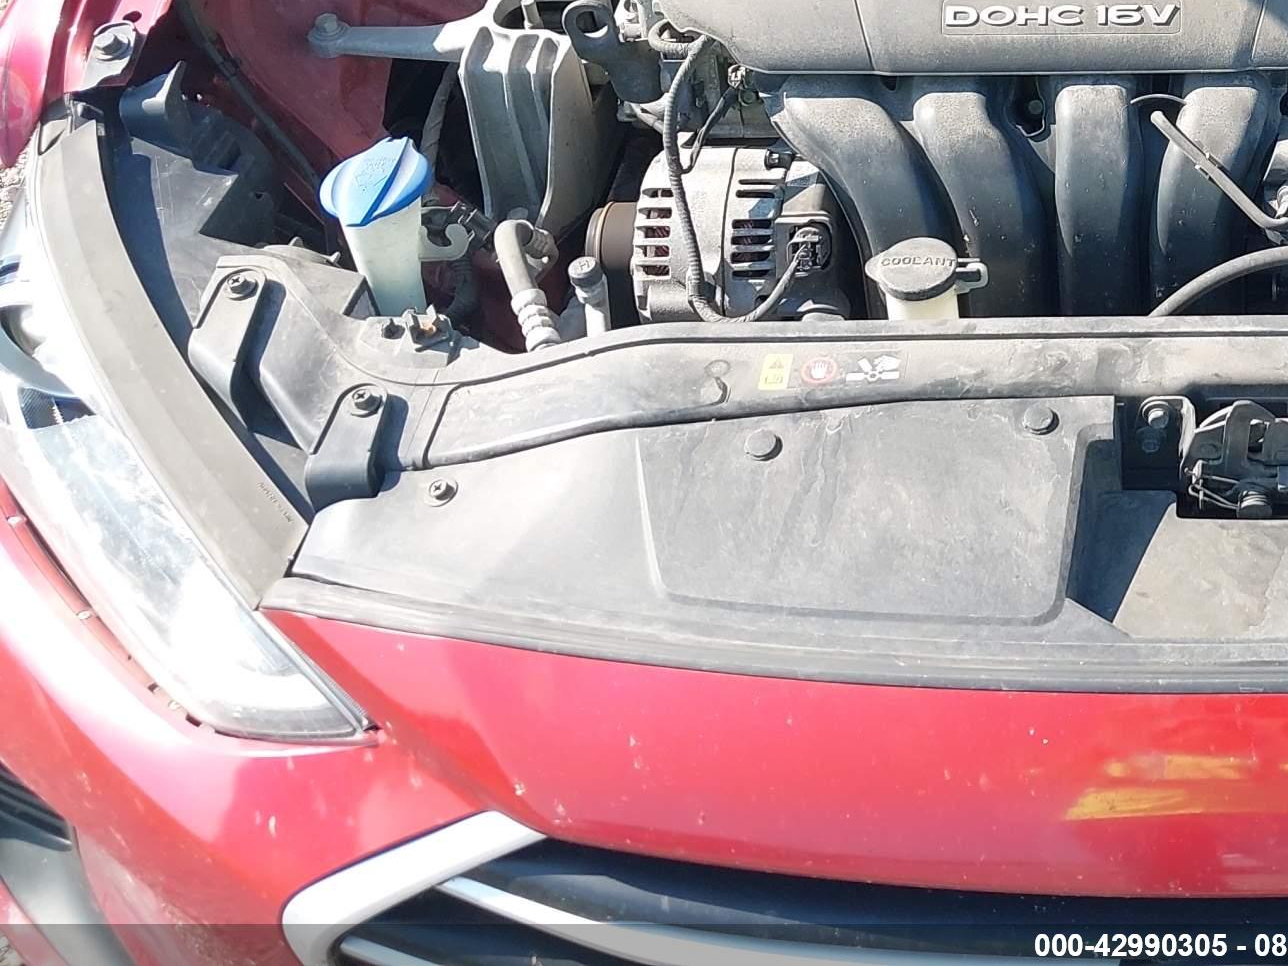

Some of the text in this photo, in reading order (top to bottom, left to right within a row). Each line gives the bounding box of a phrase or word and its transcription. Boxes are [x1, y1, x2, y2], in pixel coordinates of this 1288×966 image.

[945, 4, 1181, 27] DOHC 16V
[881, 256, 956, 268] COOLANT
